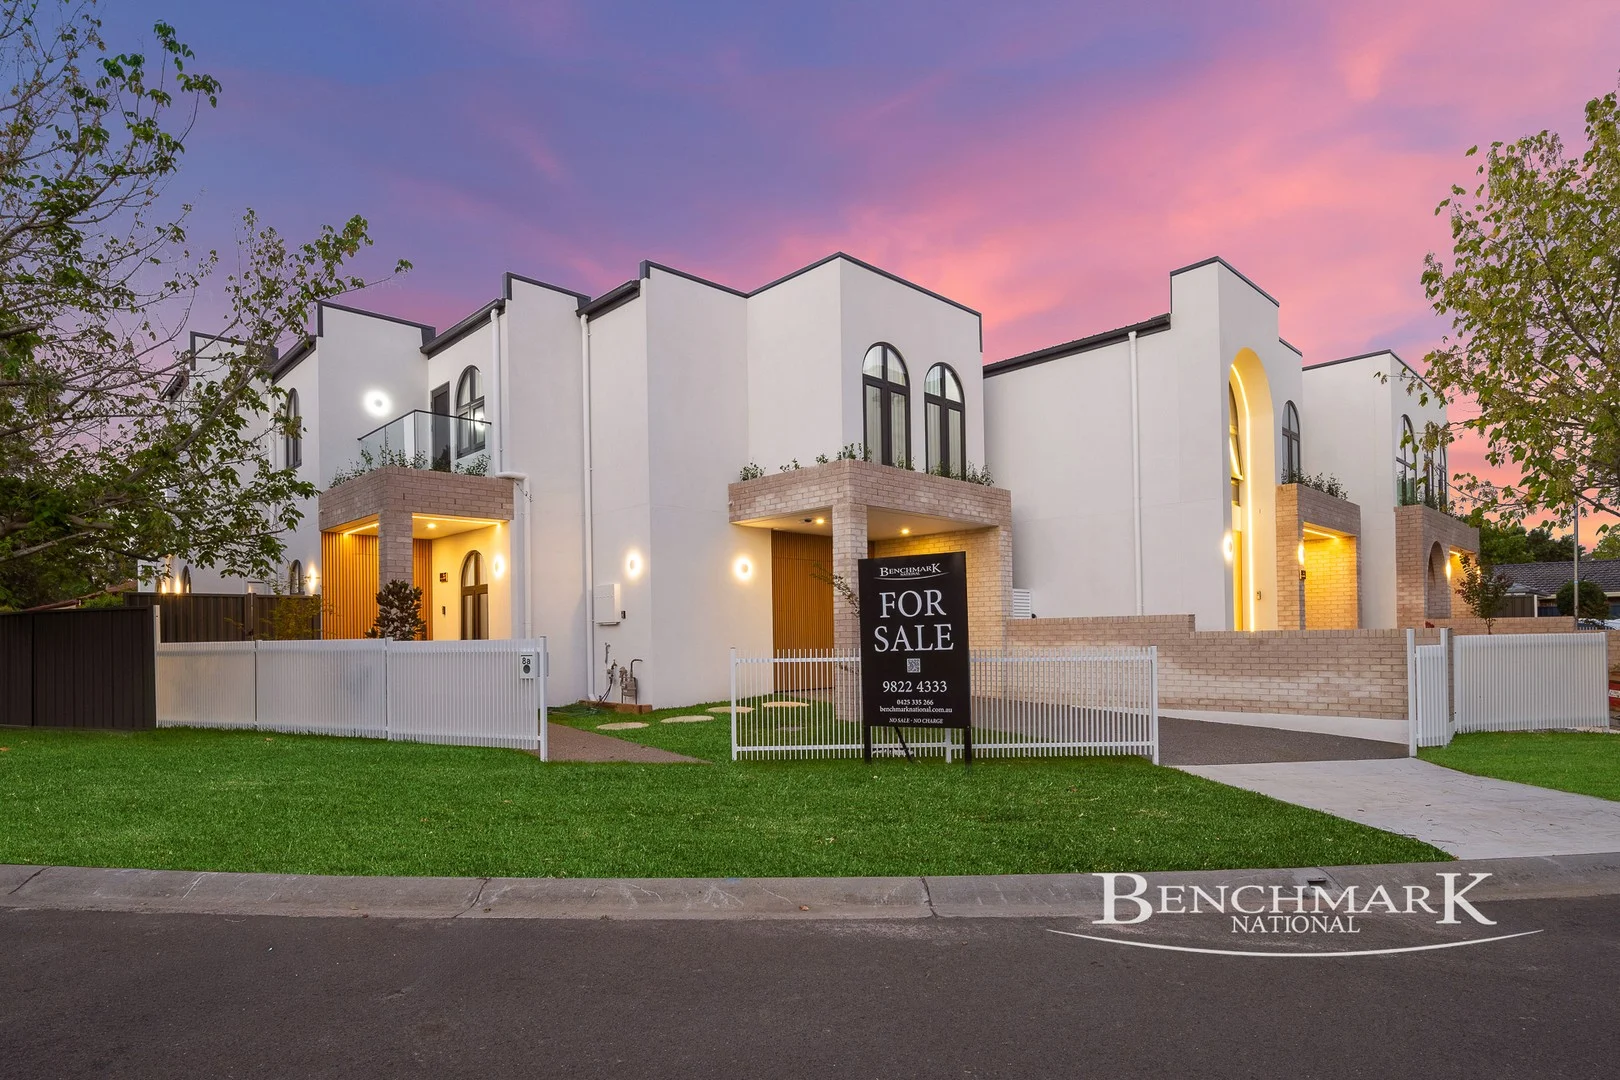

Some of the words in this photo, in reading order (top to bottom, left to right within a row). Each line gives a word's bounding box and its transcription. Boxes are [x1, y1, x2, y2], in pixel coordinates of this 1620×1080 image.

[880, 563, 941, 576] BENCHMARK
[879, 589, 946, 618] FOR
[874, 624, 954, 652] SALE
[882, 681, 912, 693] 9822
[916, 681, 947, 693] 4333
